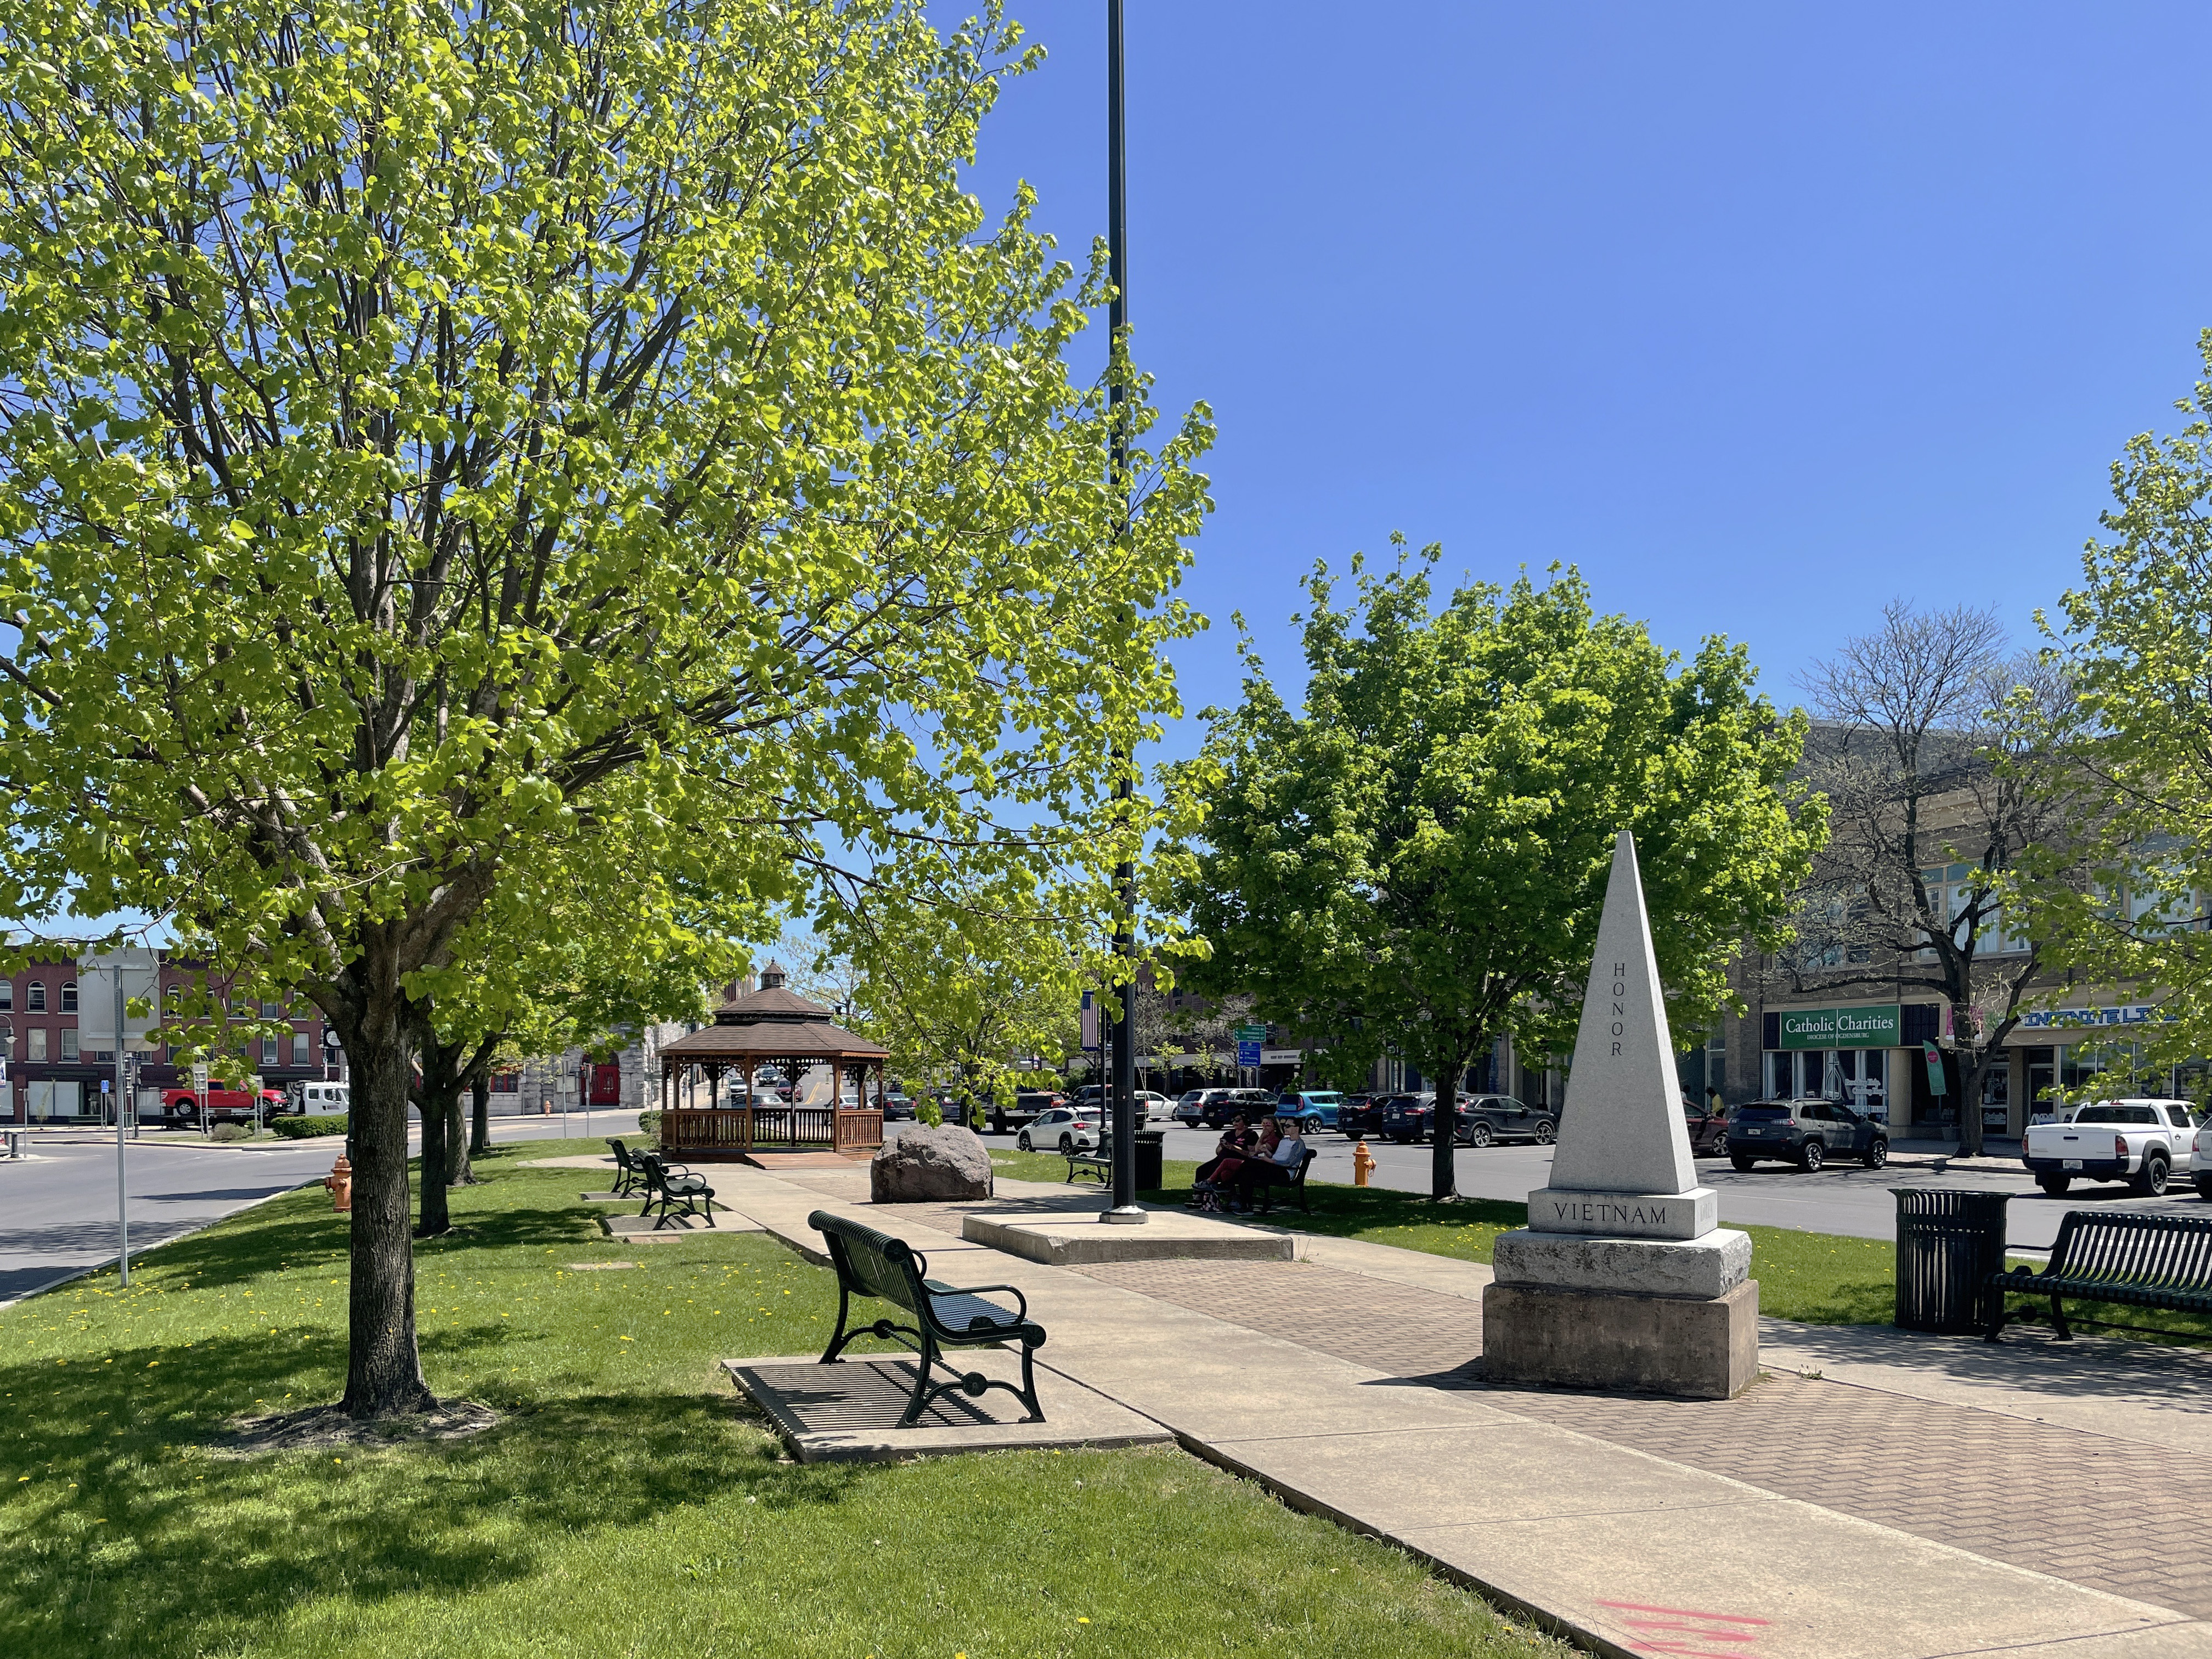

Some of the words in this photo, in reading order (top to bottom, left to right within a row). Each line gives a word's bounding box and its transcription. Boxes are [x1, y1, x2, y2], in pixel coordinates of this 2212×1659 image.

[1611, 963, 1625, 1056] HONOR
[1786, 1017, 1835, 1033] Catholic
[1838, 1015, 1894, 1031] Charities
[1554, 1203, 1666, 1223] VIETNAM
